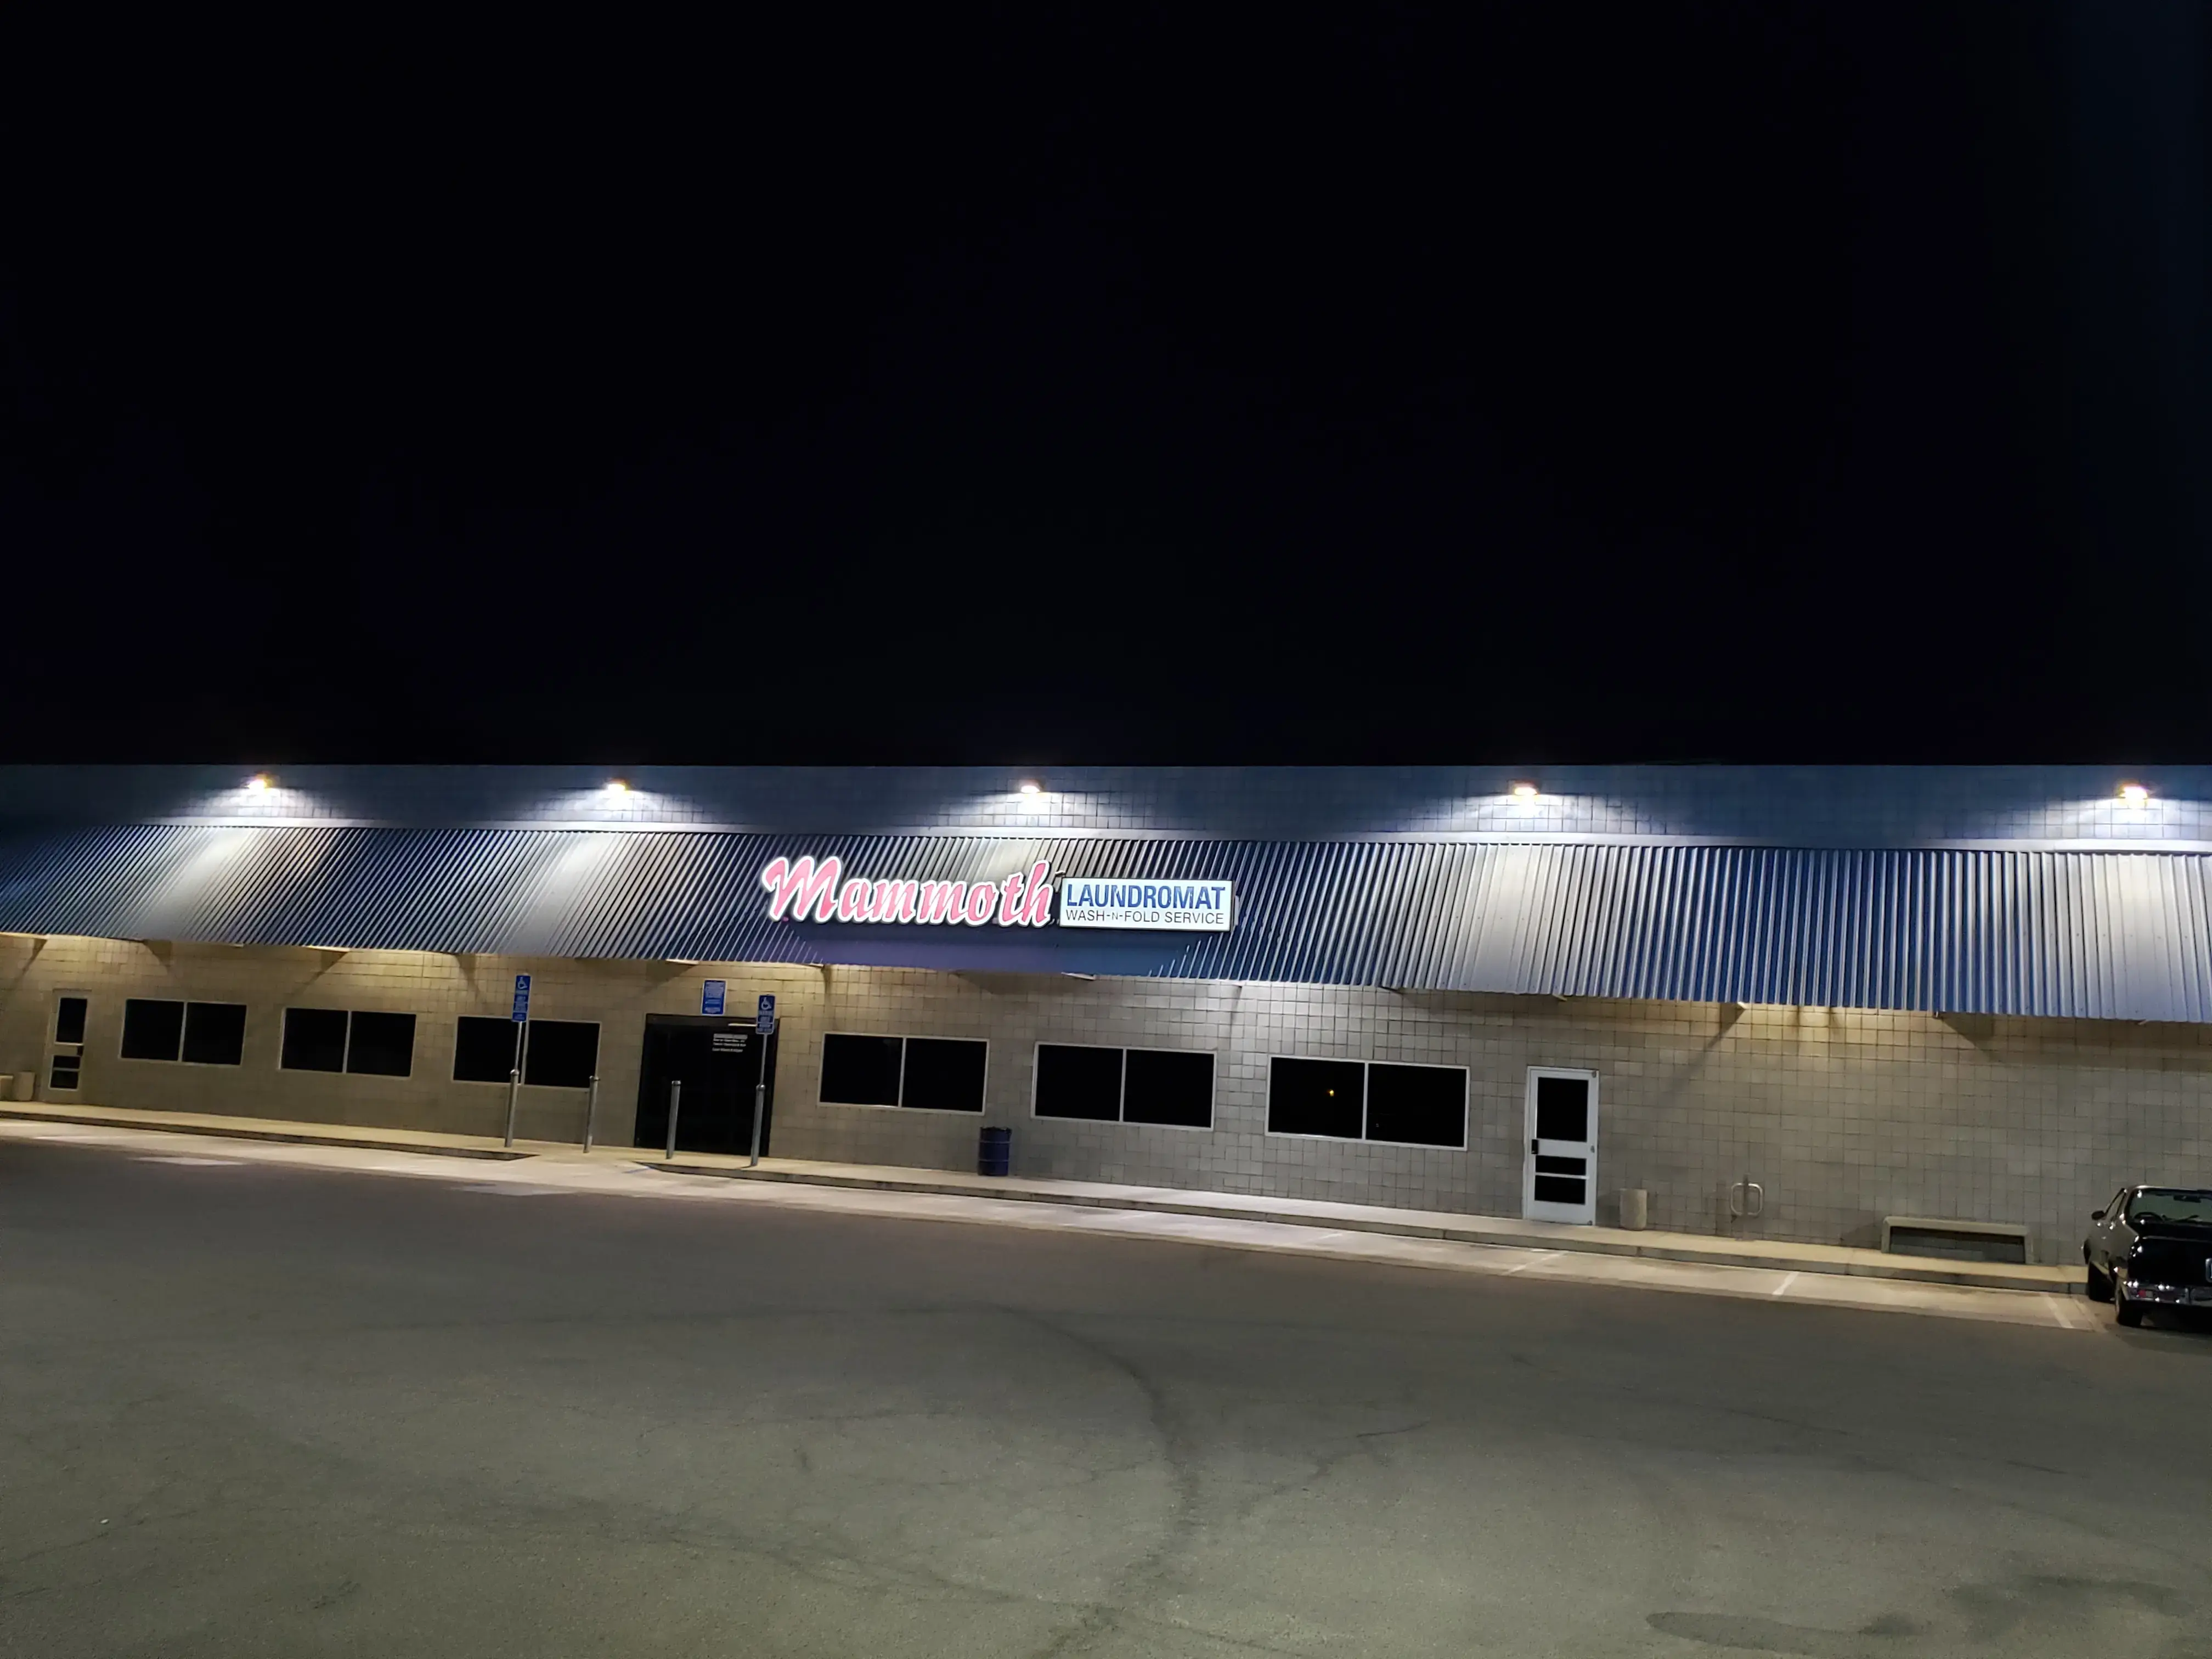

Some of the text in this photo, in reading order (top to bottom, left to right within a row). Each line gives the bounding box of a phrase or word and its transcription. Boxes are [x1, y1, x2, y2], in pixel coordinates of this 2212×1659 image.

[763, 856, 1053, 926] Mammoth
[1067, 884, 1226, 910] LAUNDROMAT
[1066, 910, 1224, 924] WASH-N-FOLD SERVICE
